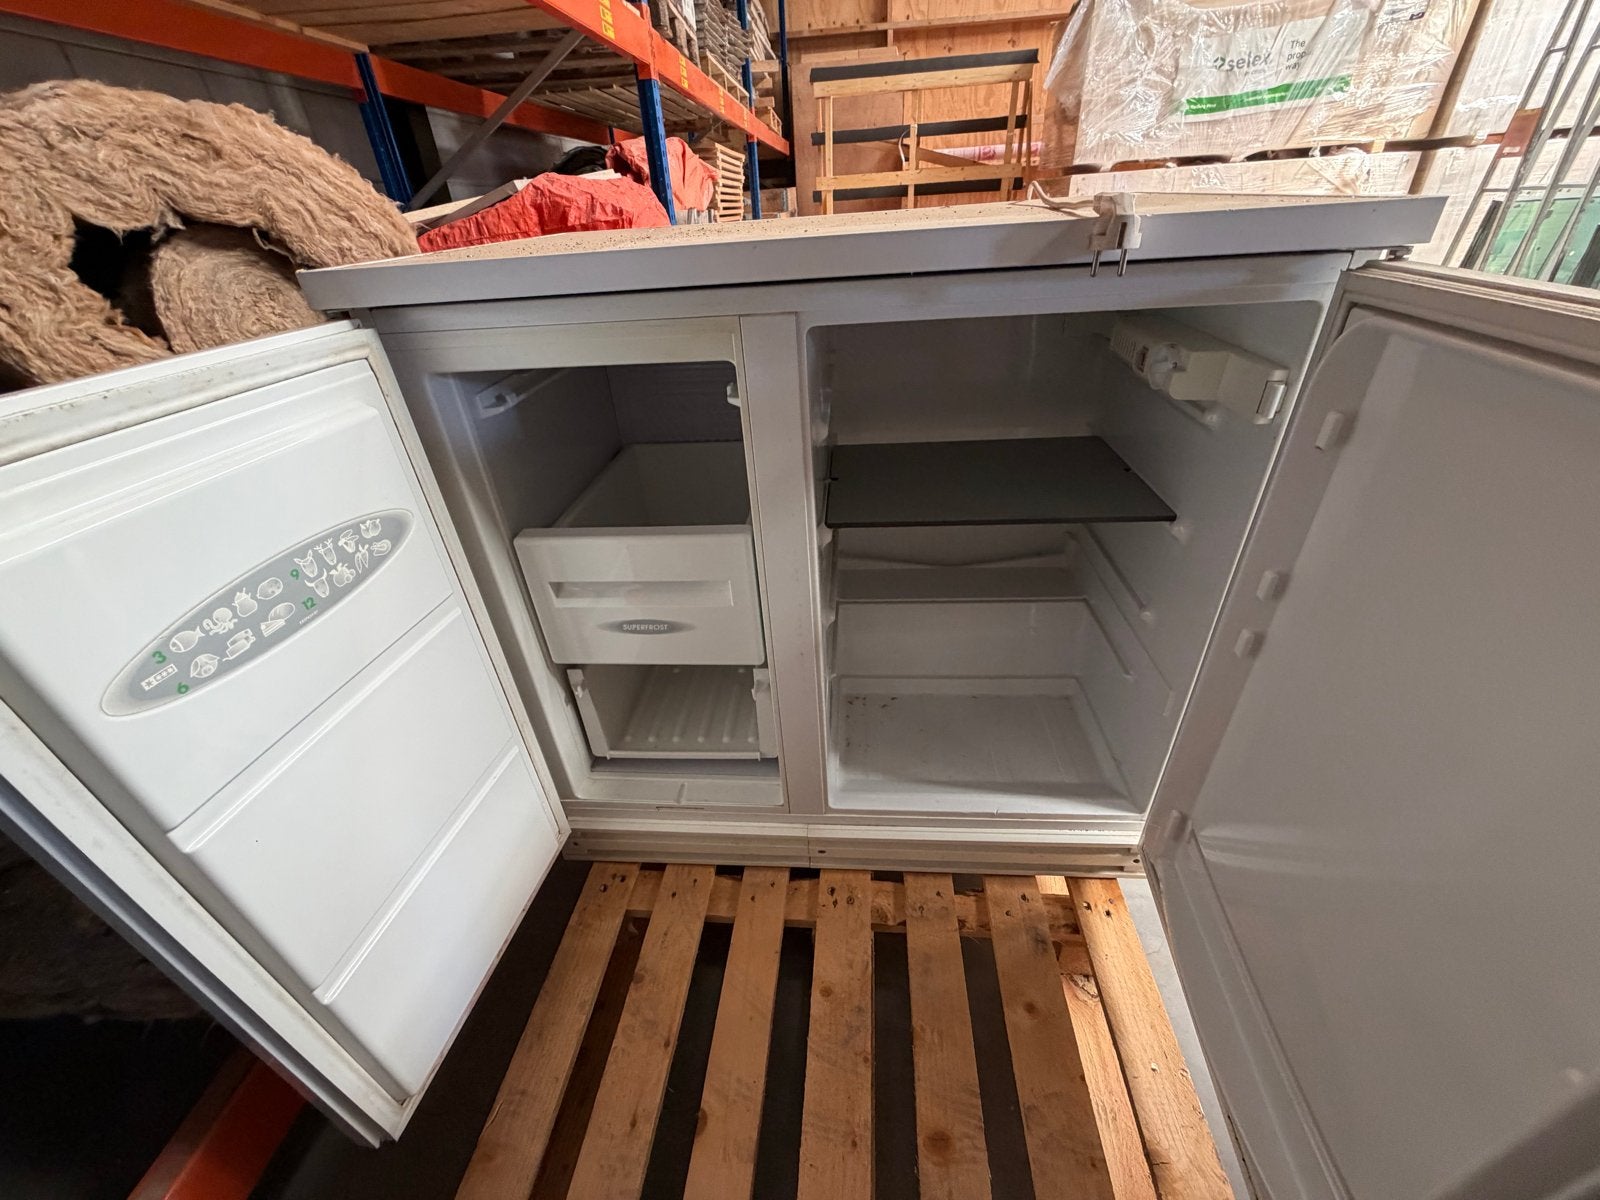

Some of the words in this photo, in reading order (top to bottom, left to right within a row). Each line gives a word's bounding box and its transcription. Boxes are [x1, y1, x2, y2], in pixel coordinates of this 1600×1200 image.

[1290, 39, 1306, 49] The
[1227, 51, 1272, 72] selex
[290, 568, 300, 581] 9
[301, 596, 317, 610] 12
[151, 650, 167, 665] 3
[176, 681, 190, 695] 6
